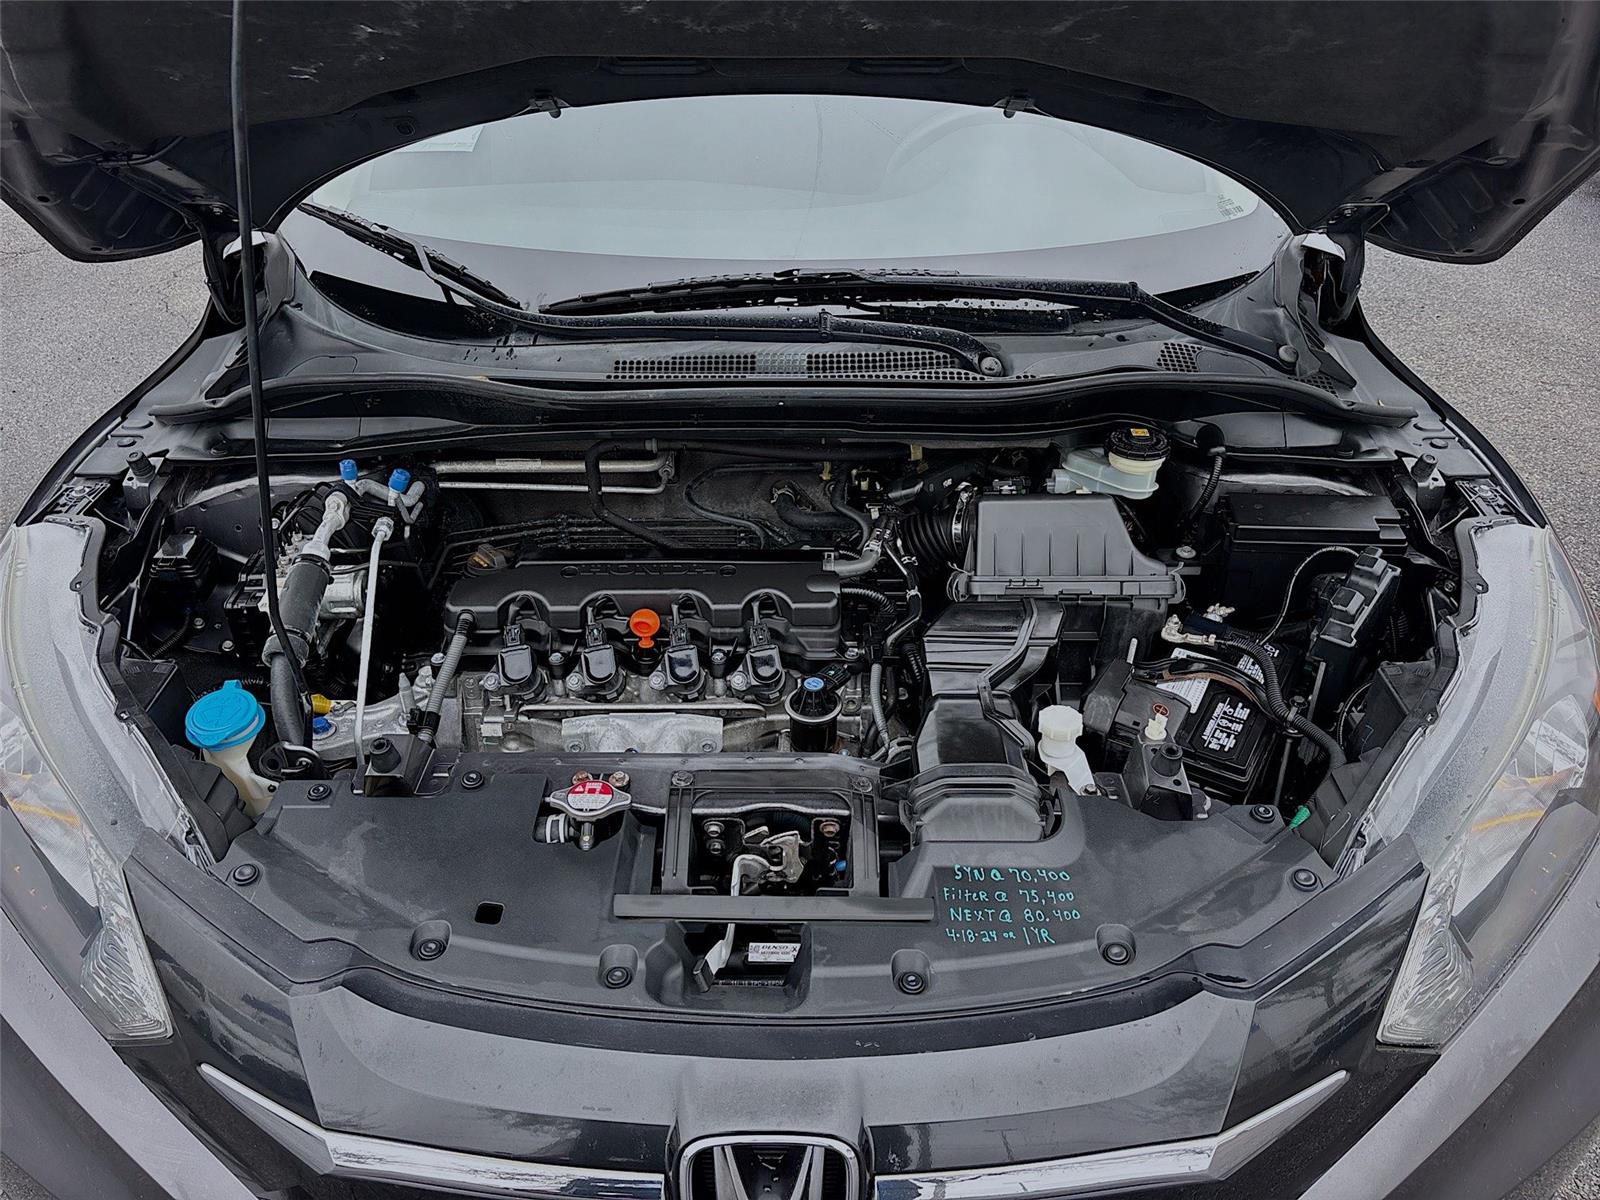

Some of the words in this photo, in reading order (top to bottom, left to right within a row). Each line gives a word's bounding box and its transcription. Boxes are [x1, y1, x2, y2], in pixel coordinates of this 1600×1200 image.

[953, 864, 985, 882] SYN
[1008, 867, 1071, 883] 70,400
[1019, 889, 1074, 905] 75,400
[950, 907, 996, 922] NEXT
